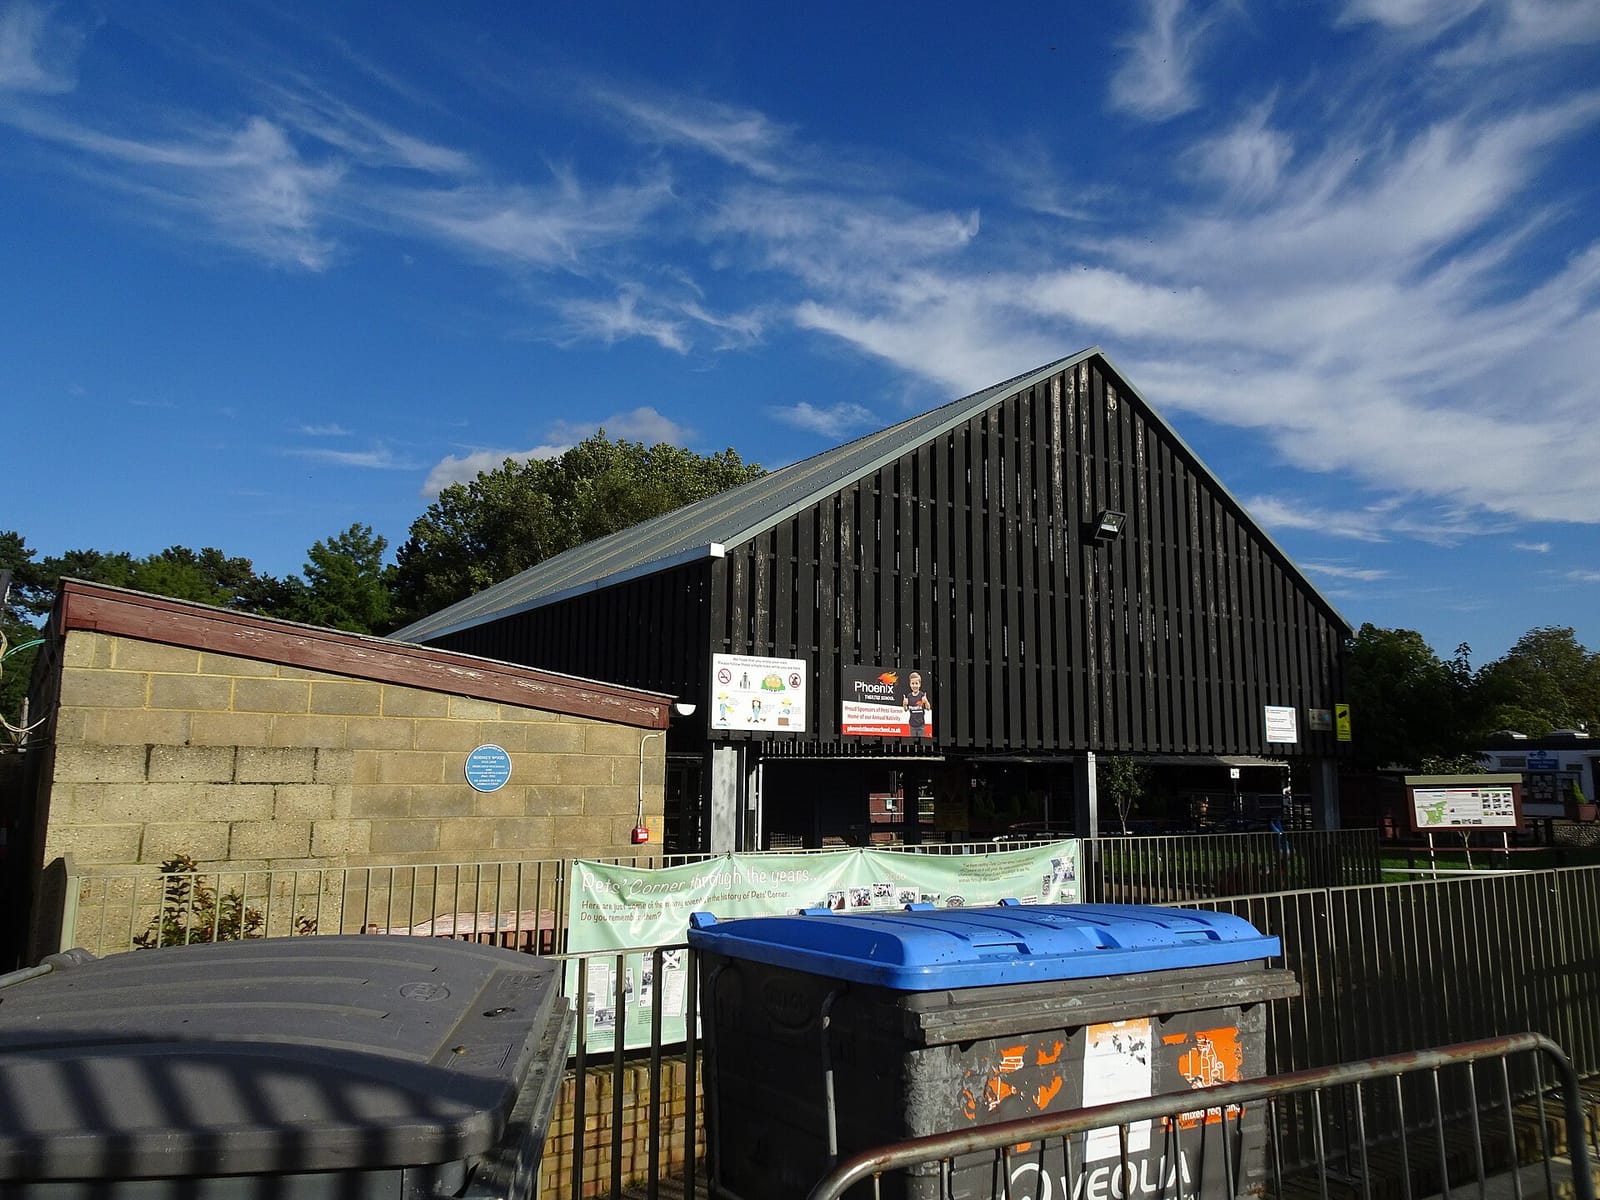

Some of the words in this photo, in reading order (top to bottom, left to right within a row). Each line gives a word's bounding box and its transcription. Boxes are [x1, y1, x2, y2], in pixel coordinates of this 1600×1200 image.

[854, 680, 894, 694] Phoenix
[582, 872, 627, 894] Pets'
[629, 878, 687, 896] Corner
[690, 865, 741, 889] through
[747, 866, 767, 884] the
[581, 901, 600, 910] Here
[720, 892, 742, 903] history
[742, 890, 751, 900] of
[580, 912, 592, 921] Do
[593, 914, 607, 923] you
[609, 912, 641, 922] remembr
[1060, 1151, 1191, 1200] VEOLIA
